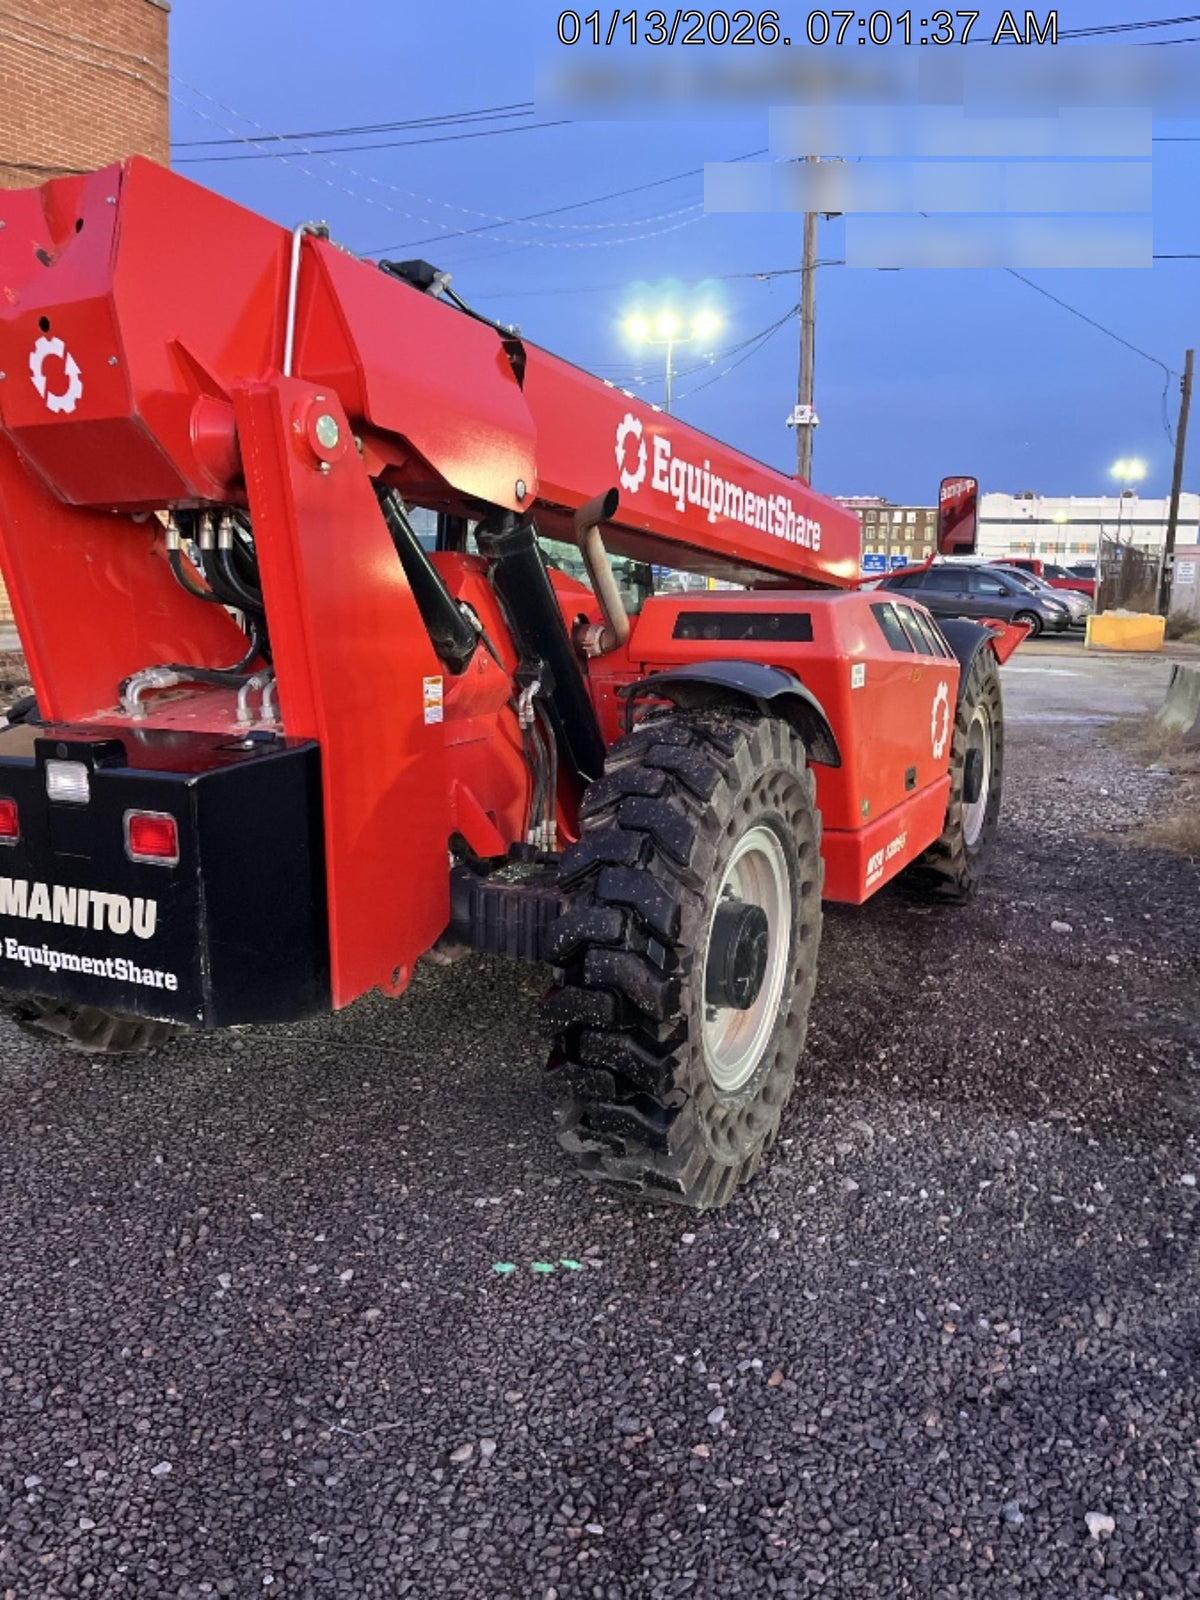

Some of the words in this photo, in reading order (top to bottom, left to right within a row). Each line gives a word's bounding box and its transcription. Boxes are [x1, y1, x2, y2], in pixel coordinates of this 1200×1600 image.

[651, 435, 822, 552] EquipmentShare
[0, 876, 158, 939] MANITOU
[4, 937, 179, 991] EquipmentShare
